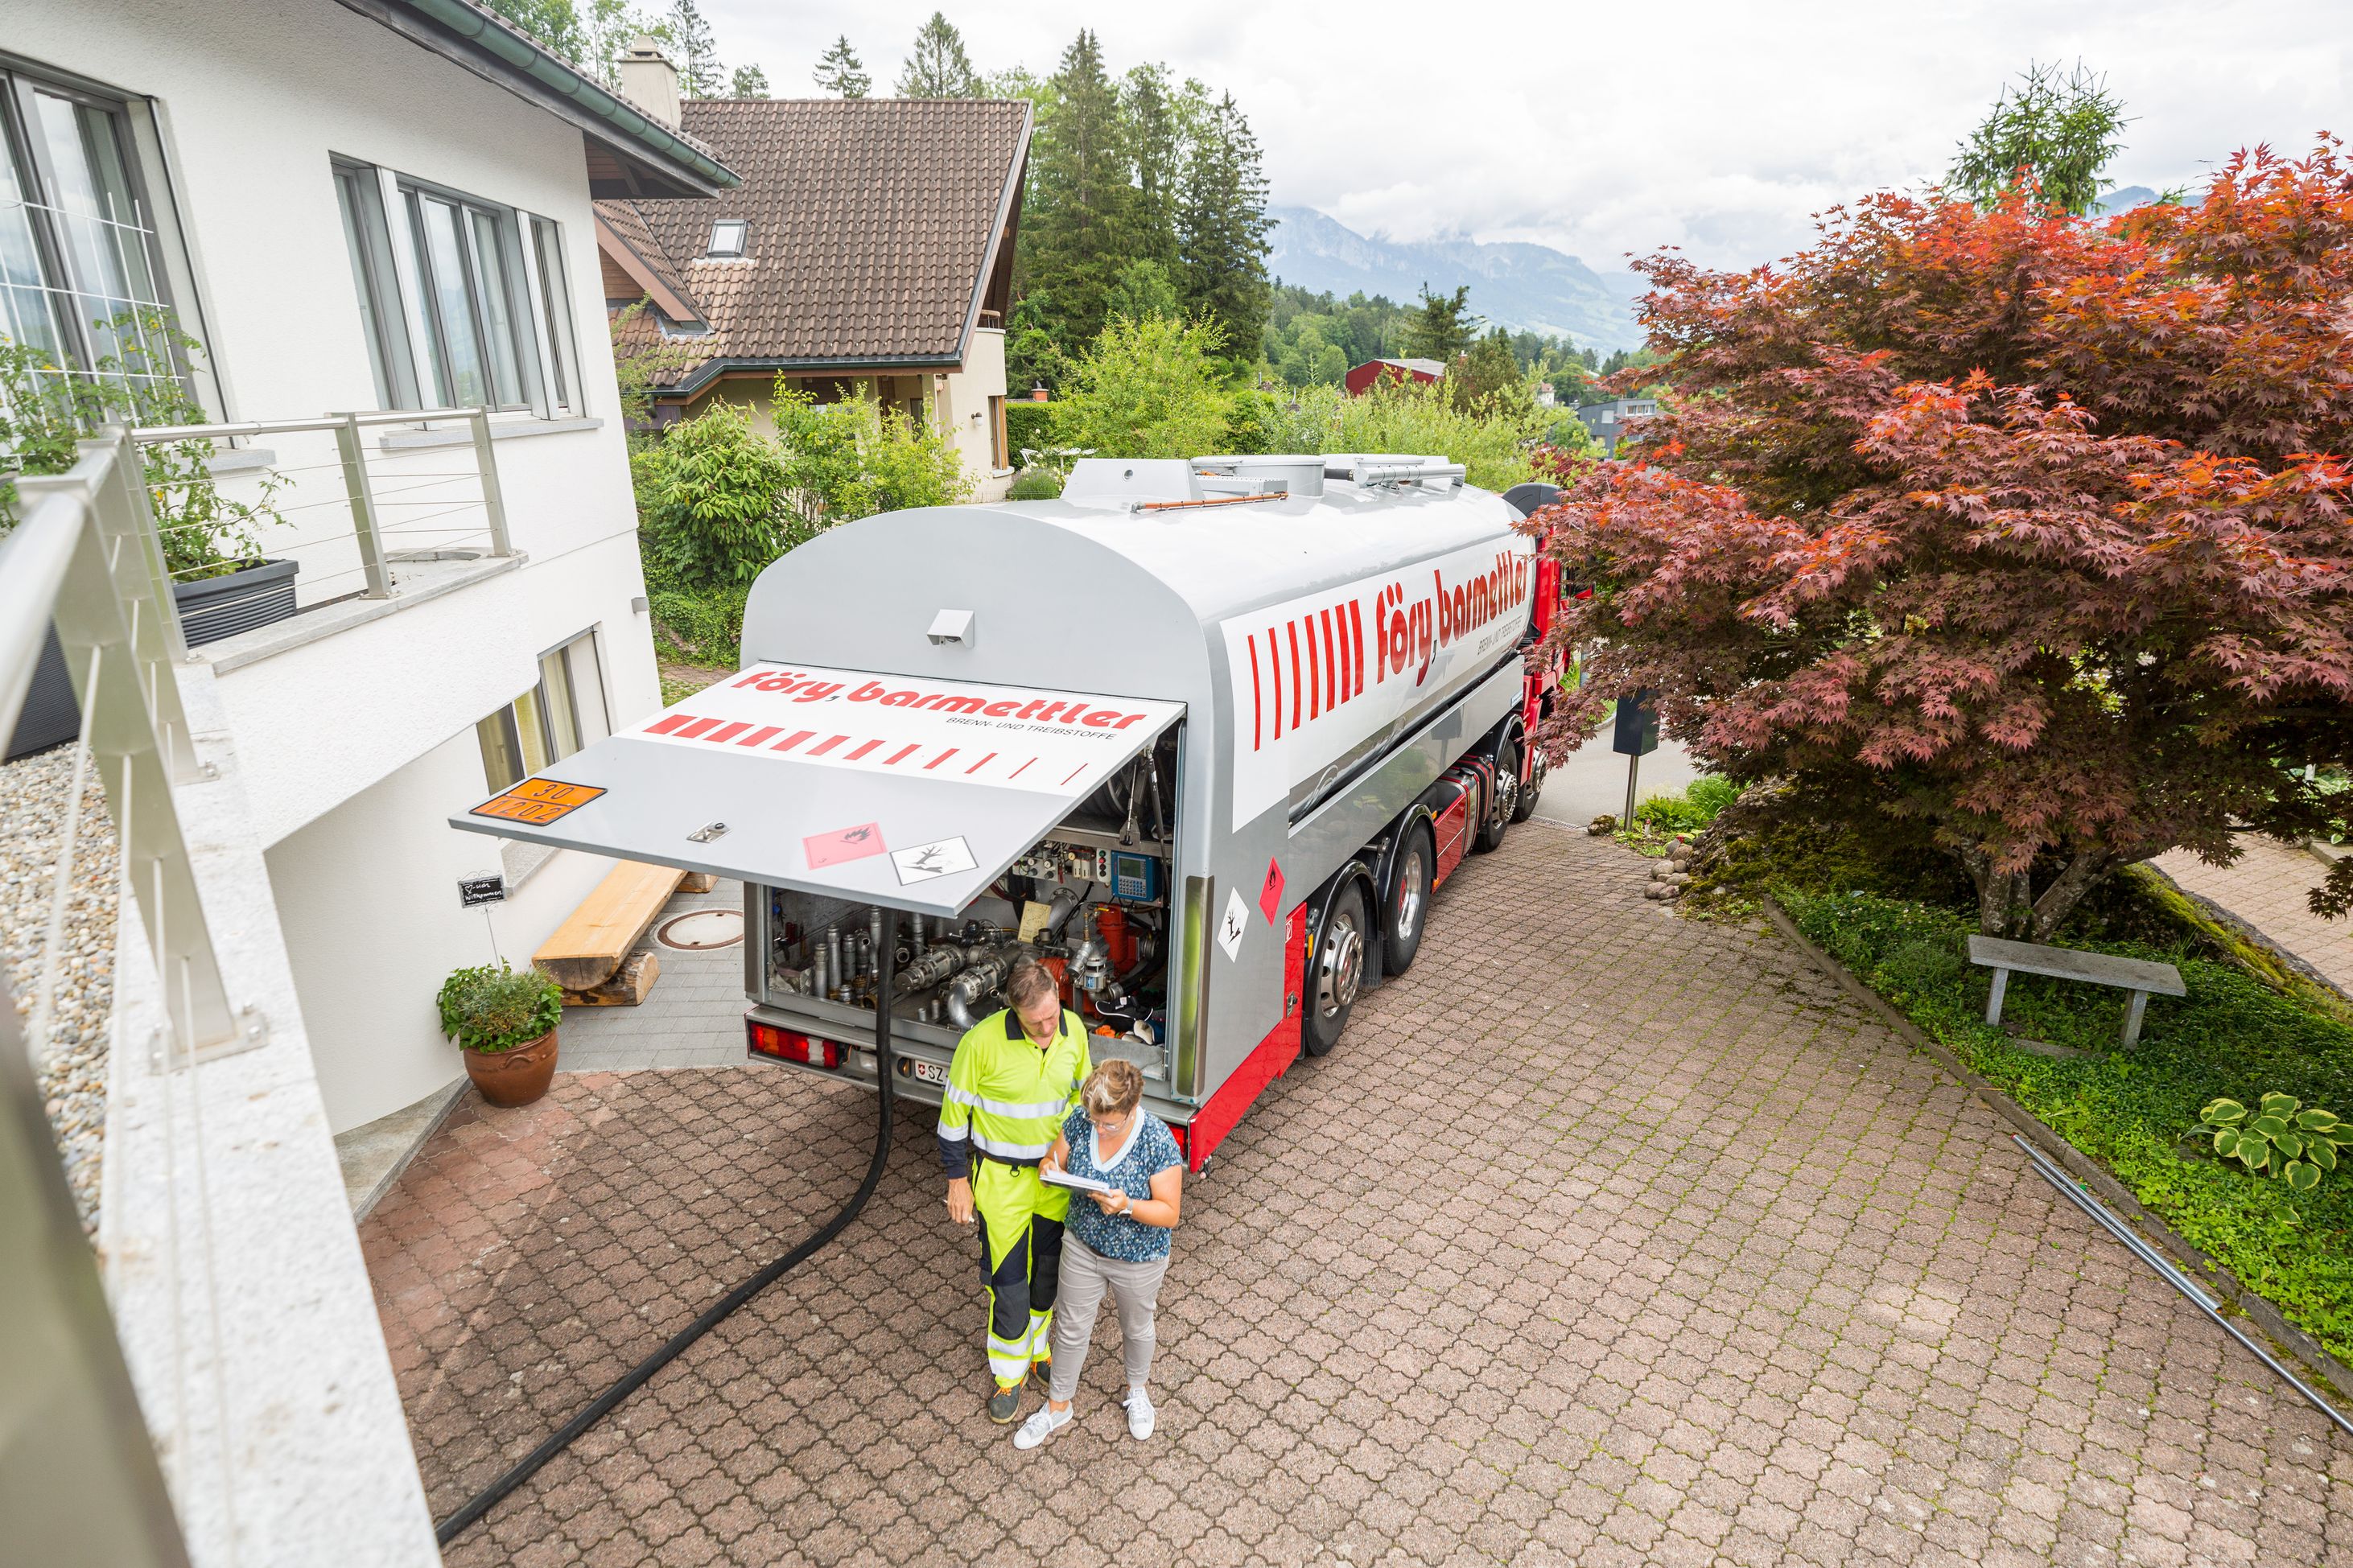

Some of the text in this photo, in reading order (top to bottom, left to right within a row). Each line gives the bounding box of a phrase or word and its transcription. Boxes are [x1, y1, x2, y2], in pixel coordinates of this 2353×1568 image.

[1434, 549, 1527, 648] barmettler
[847, 681, 1148, 730] barmettler
[946, 717, 1117, 740] BRENN- UND TREIBSTOFFE
[533, 784, 575, 800] 30
[487, 800, 562, 820] 1202
